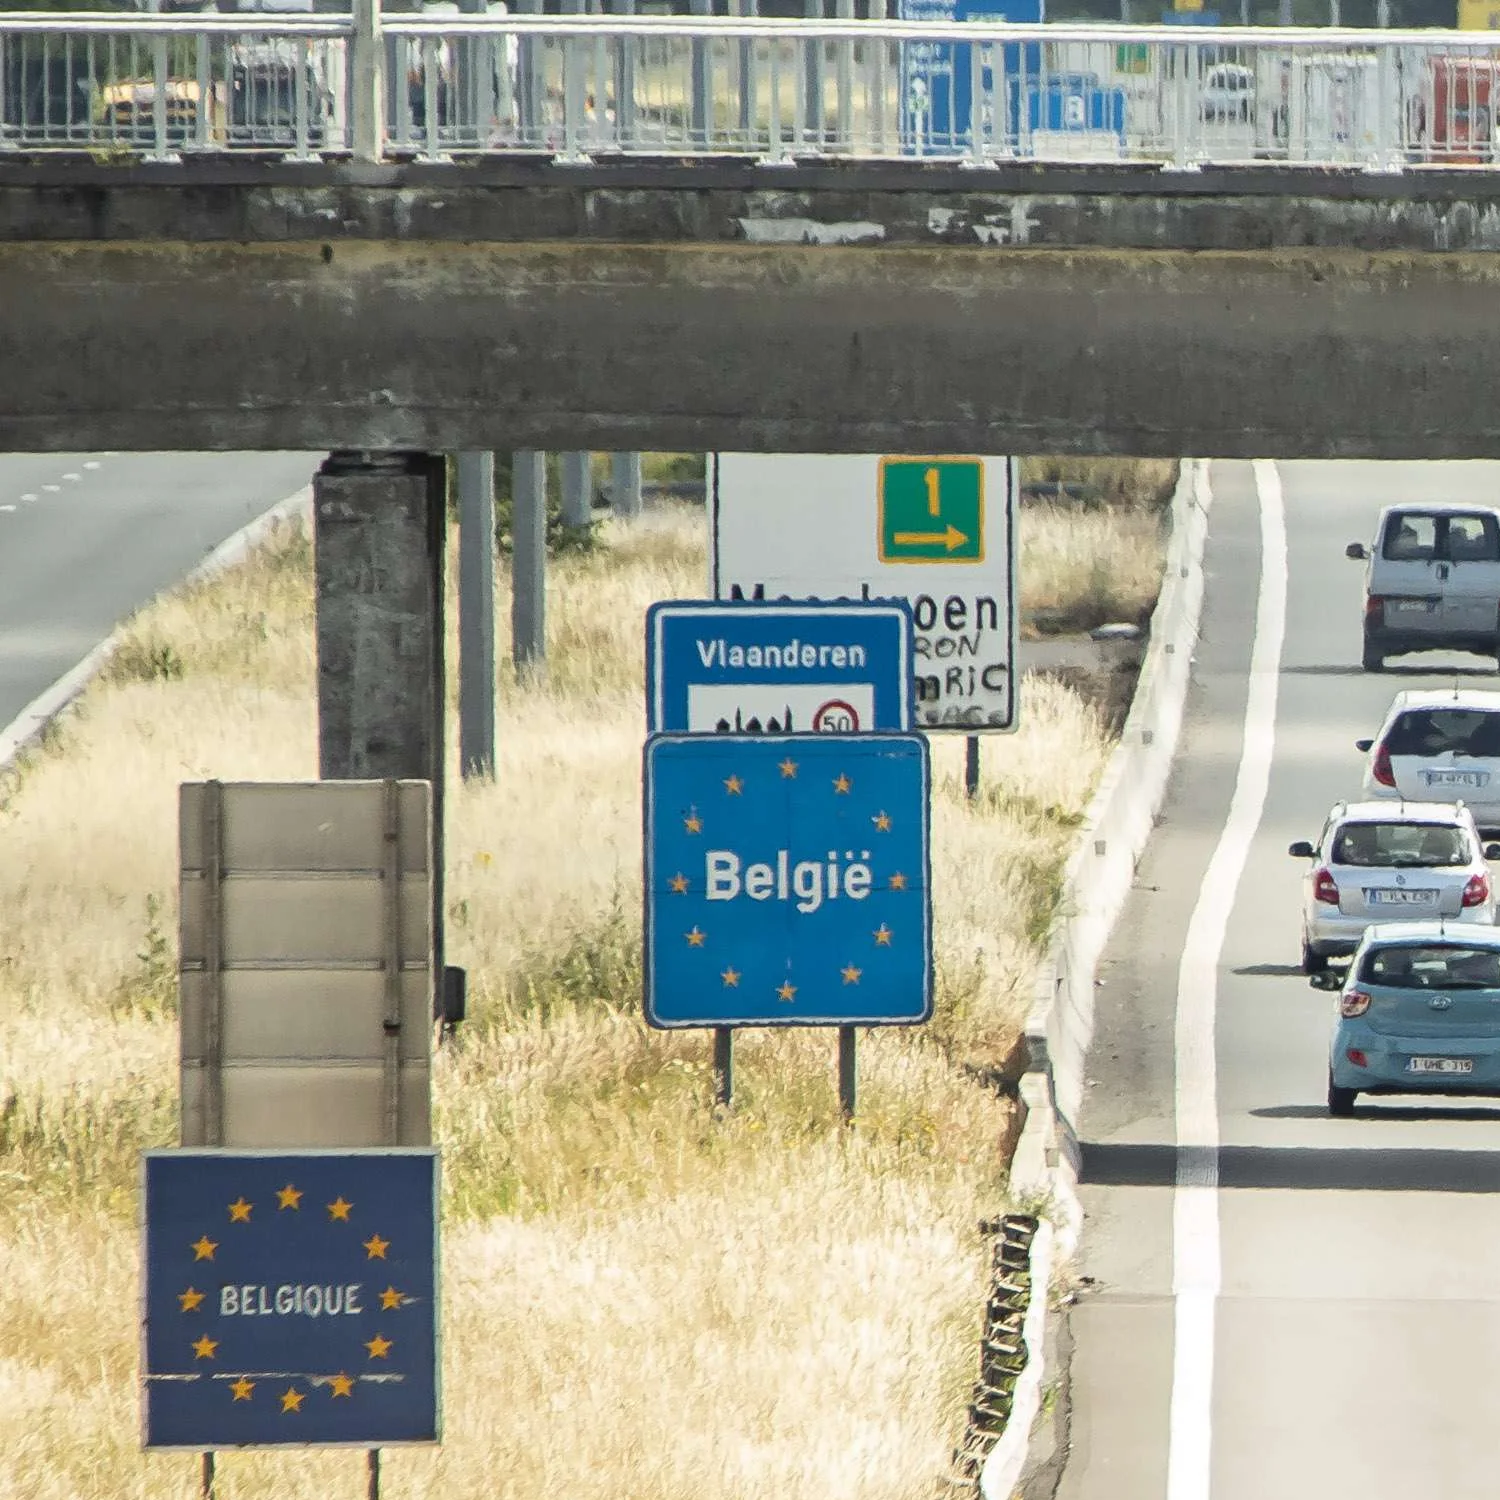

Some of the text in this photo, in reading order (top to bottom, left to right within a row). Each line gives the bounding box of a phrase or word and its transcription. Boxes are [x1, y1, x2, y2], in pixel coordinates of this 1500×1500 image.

[923, 467, 941, 516] 1
[696, 639, 866, 668] Vlaanderen
[705, 849, 872, 913] België
[220, 1284, 364, 1318] BELGIQUE
